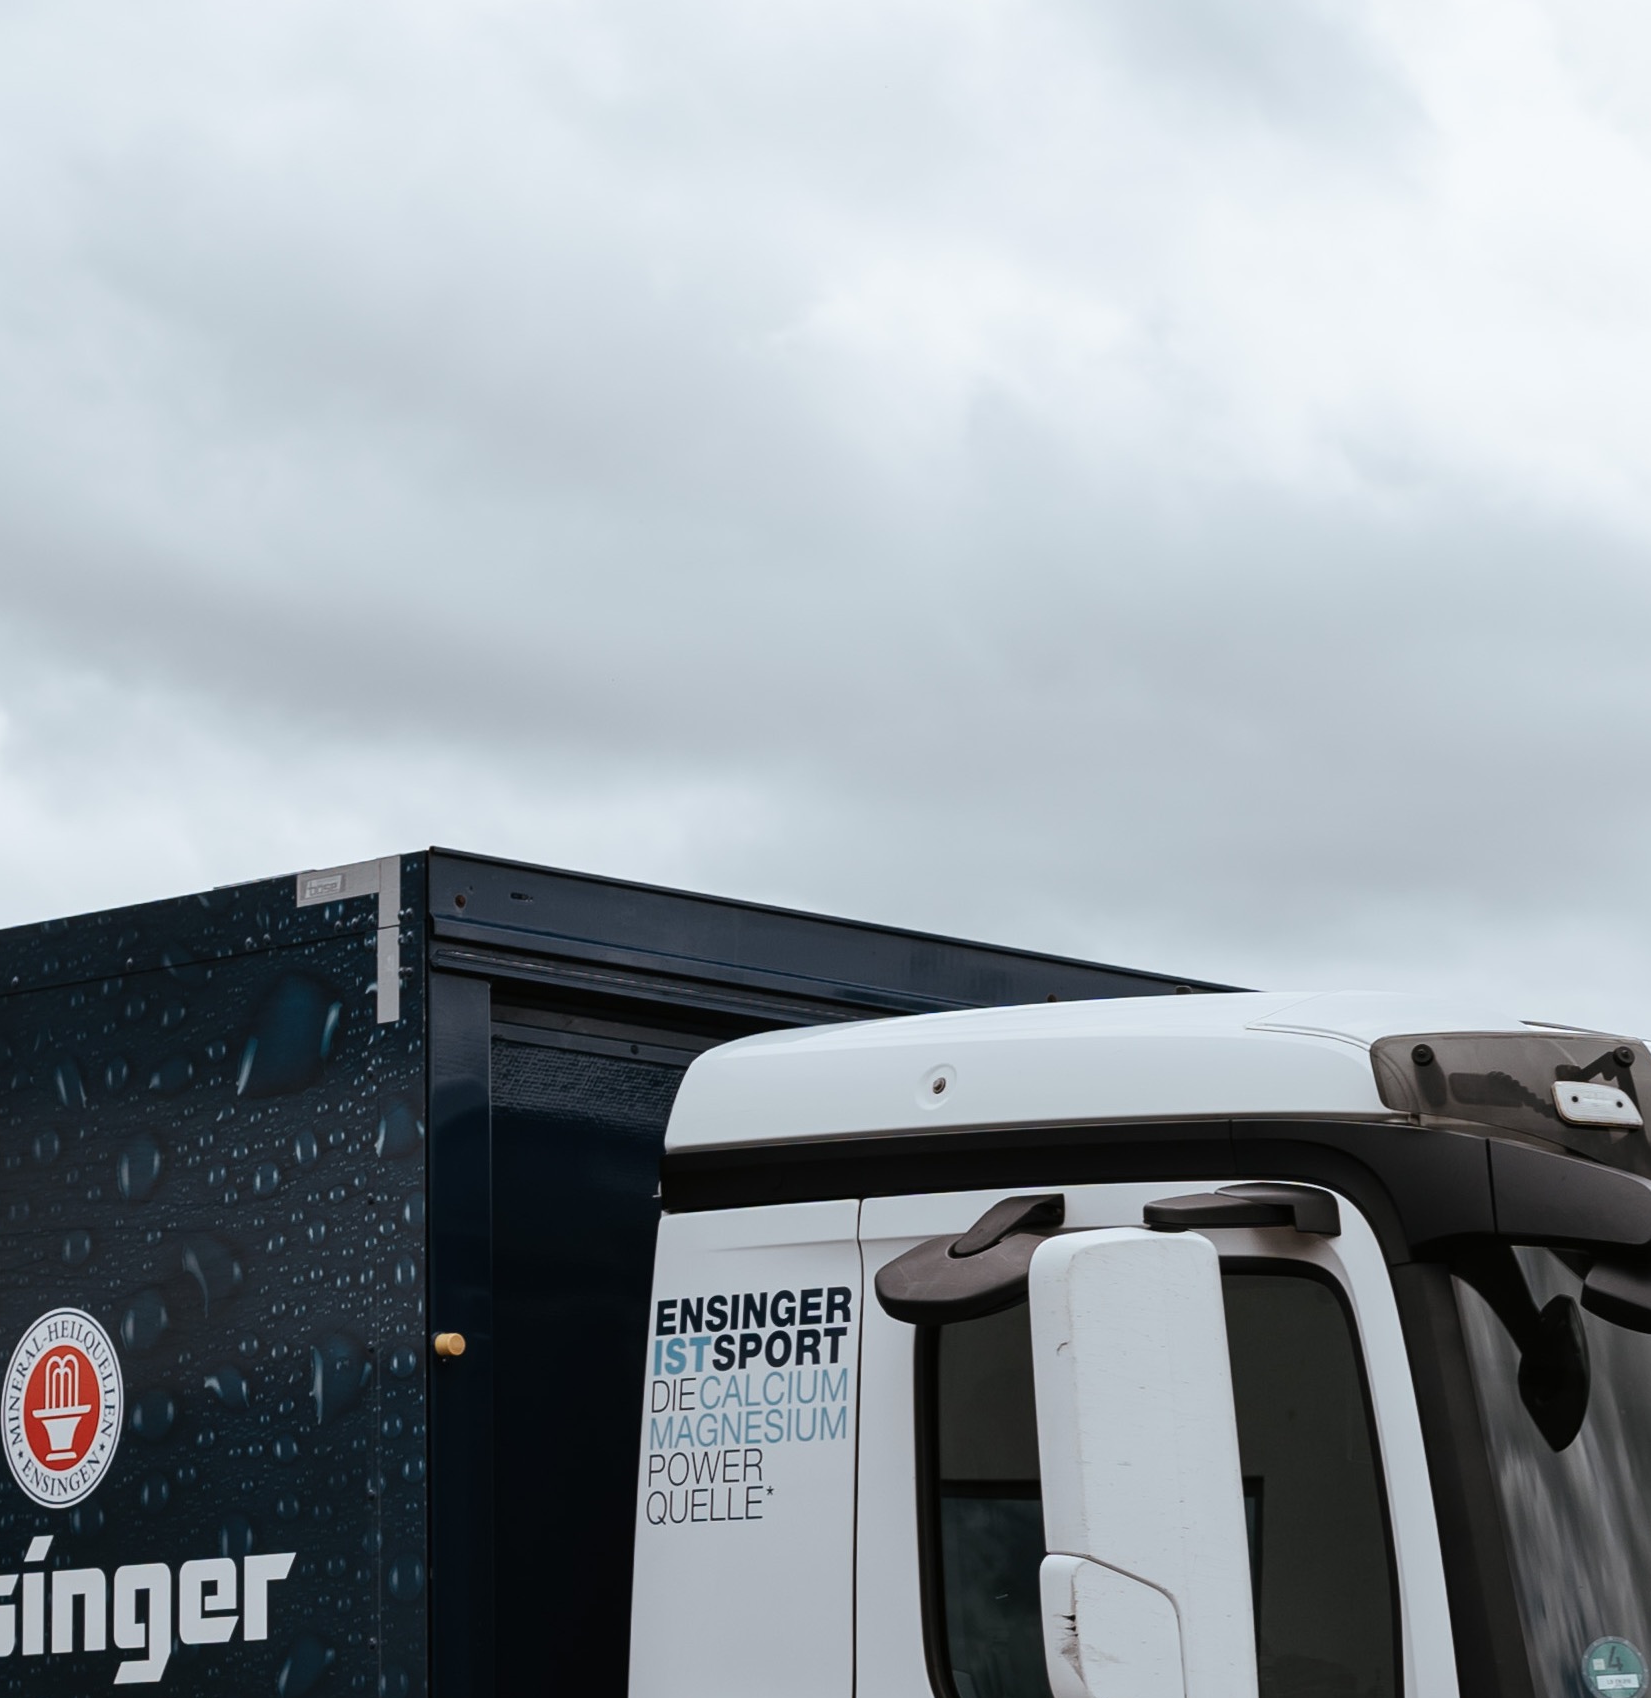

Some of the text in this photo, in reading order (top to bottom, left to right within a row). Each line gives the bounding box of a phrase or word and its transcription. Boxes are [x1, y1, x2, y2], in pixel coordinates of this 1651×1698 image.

[655, 1286, 852, 1336] ENSINGER
[8, 1320, 117, 1447] MINERAL-HEILQUELLEN
[650, 1405, 847, 1451] MAGNESIUM
[21, 1454, 103, 1497] ENSINGEN
[648, 1448, 763, 1487] POWER
